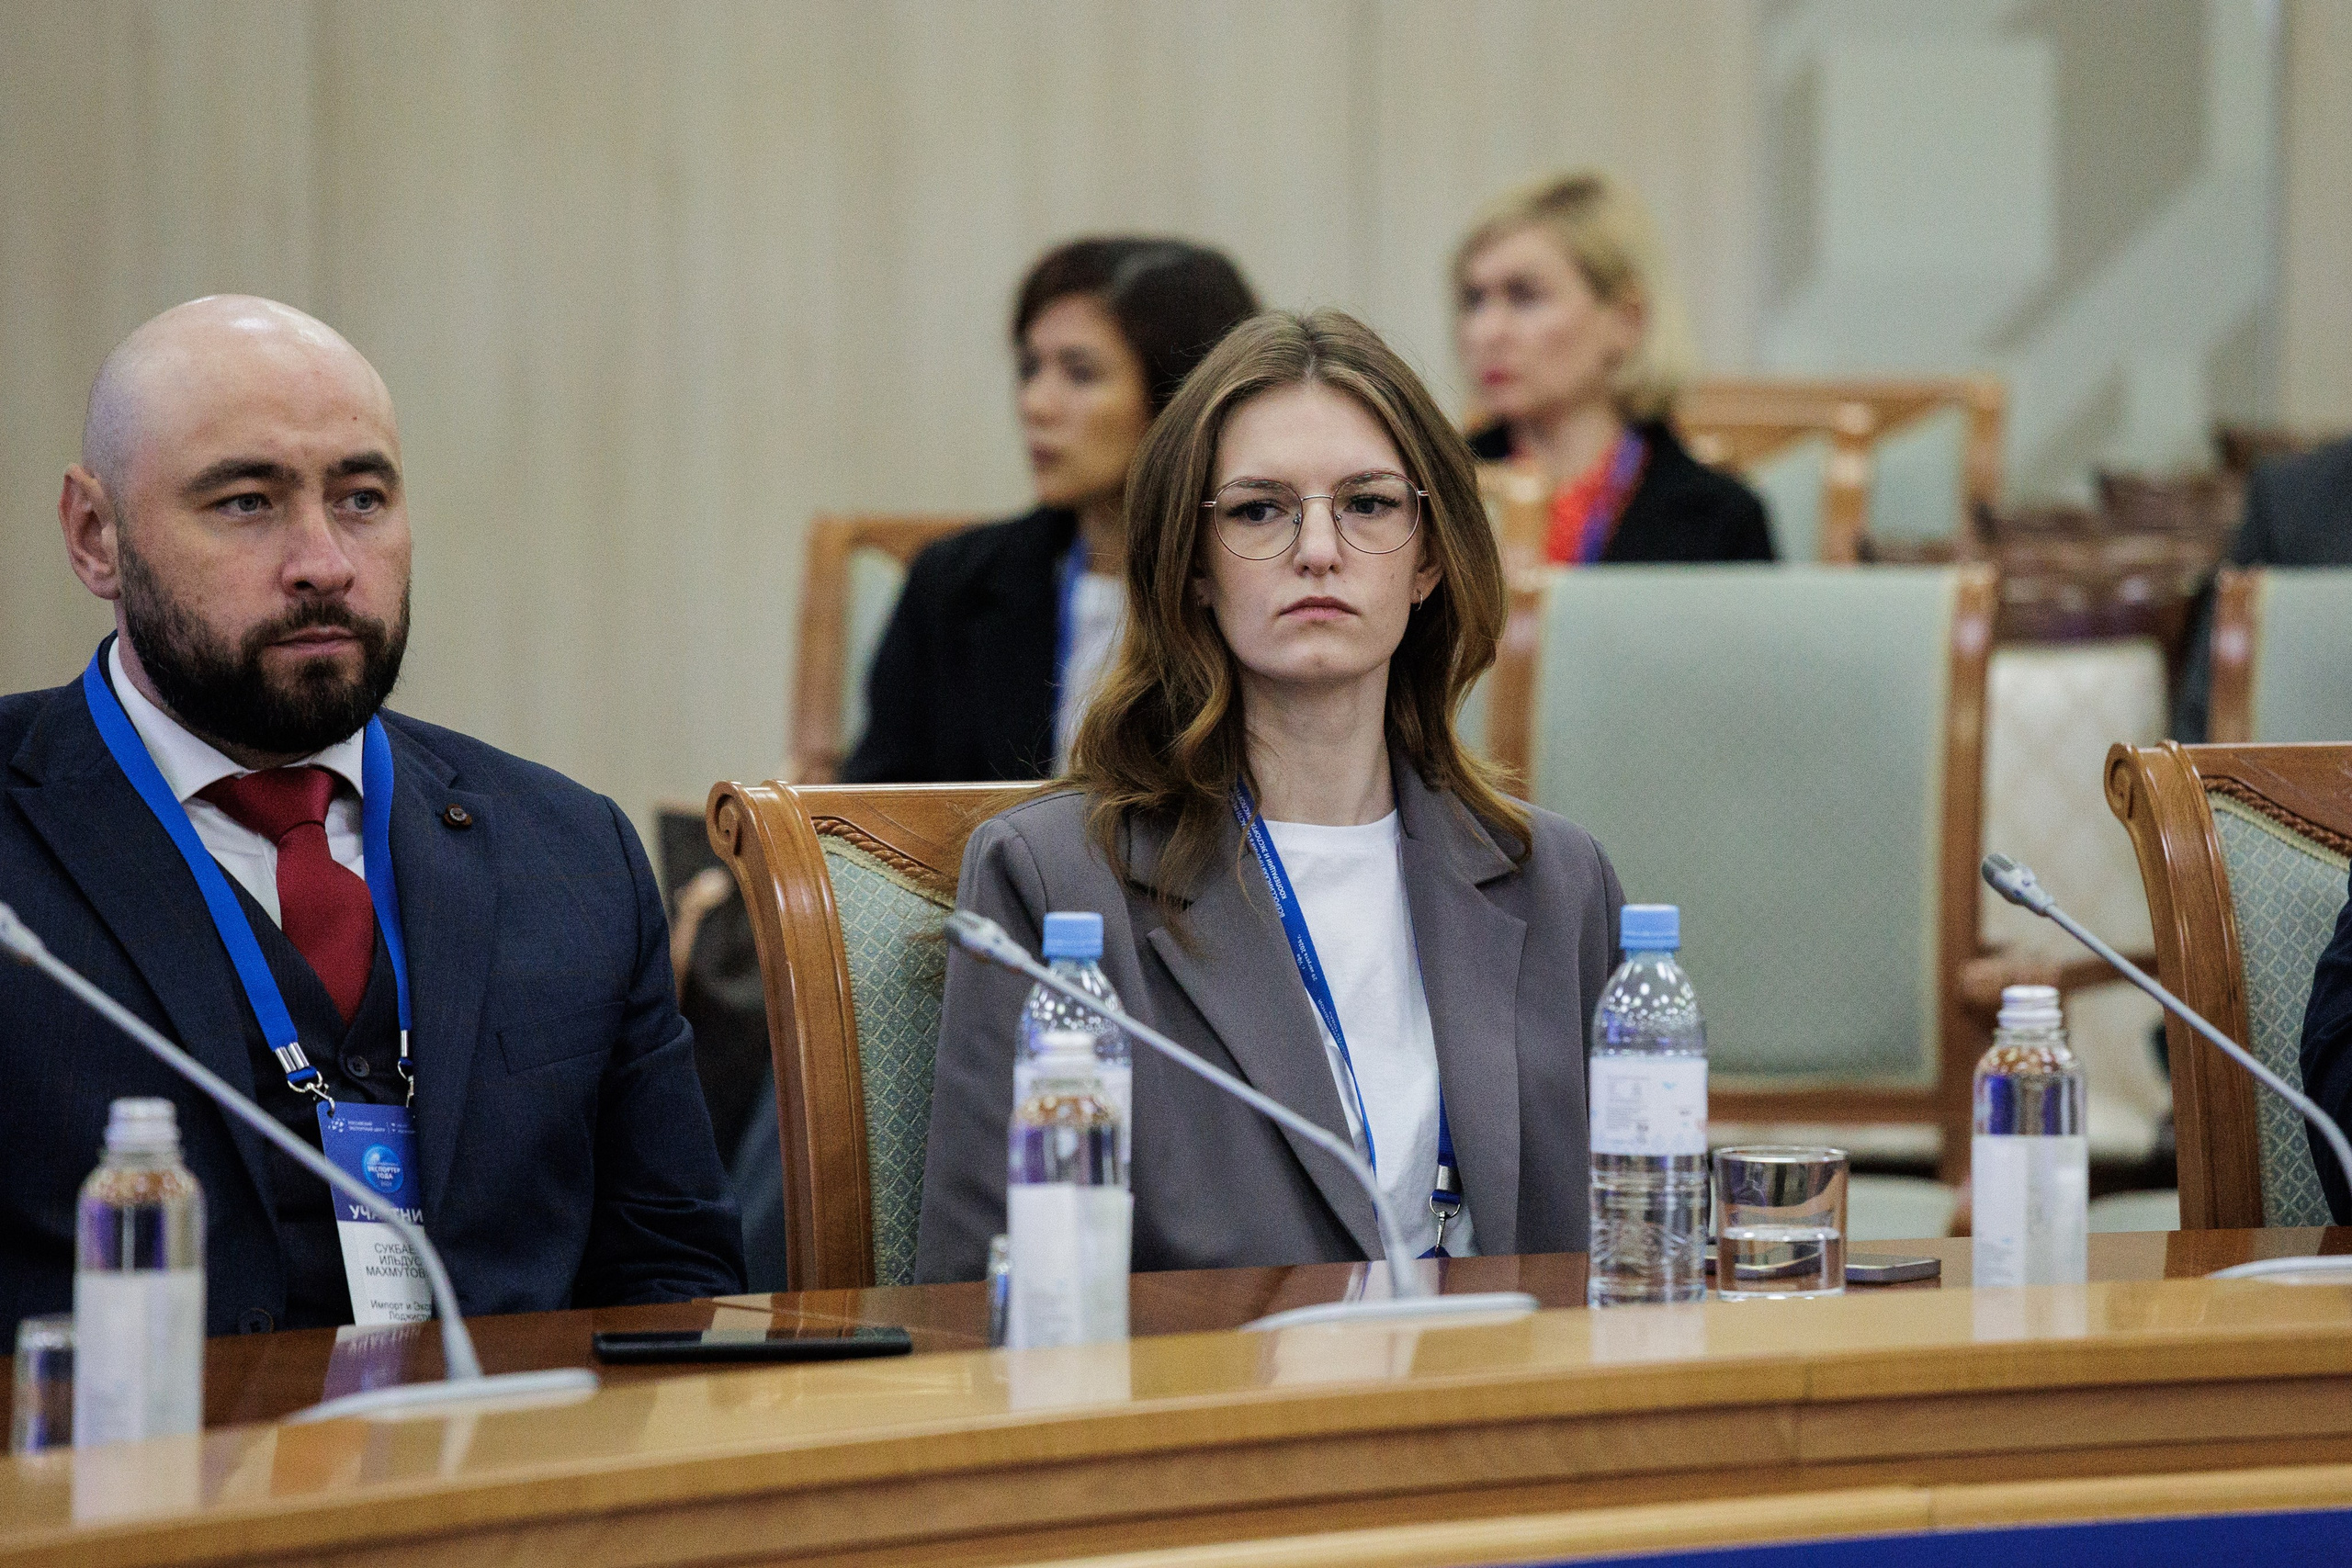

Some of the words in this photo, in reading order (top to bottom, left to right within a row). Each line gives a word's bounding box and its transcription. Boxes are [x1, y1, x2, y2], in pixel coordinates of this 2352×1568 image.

[1250, 821, 1268, 853] ЭКСПОРТА
[1265, 857, 1287, 899] КООПЕРАЦИИ
[1303, 953, 1315, 974] августа
[370, 1300, 403, 1311] Импорт
